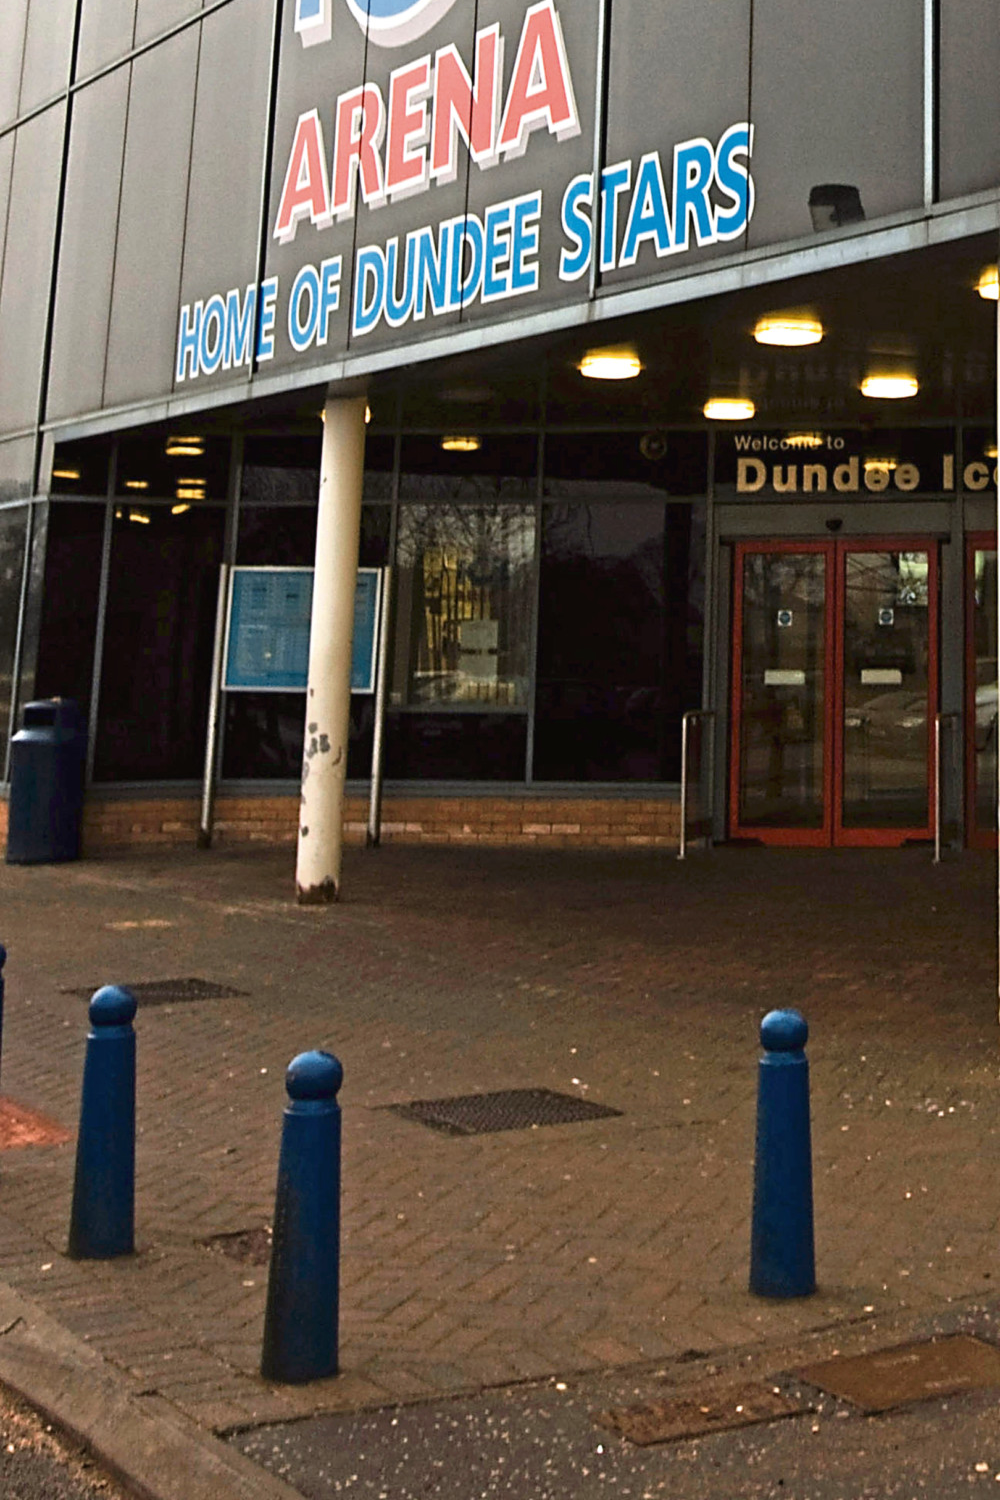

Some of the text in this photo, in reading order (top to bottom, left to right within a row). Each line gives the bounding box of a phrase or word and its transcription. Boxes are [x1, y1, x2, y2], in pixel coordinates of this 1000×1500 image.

[175, 122, 755, 382] HOME OF DUNDEE STARS
[827, 435, 845, 450] to
[736, 454, 920, 492] Dundee
[942, 453, 998, 490] Ic
